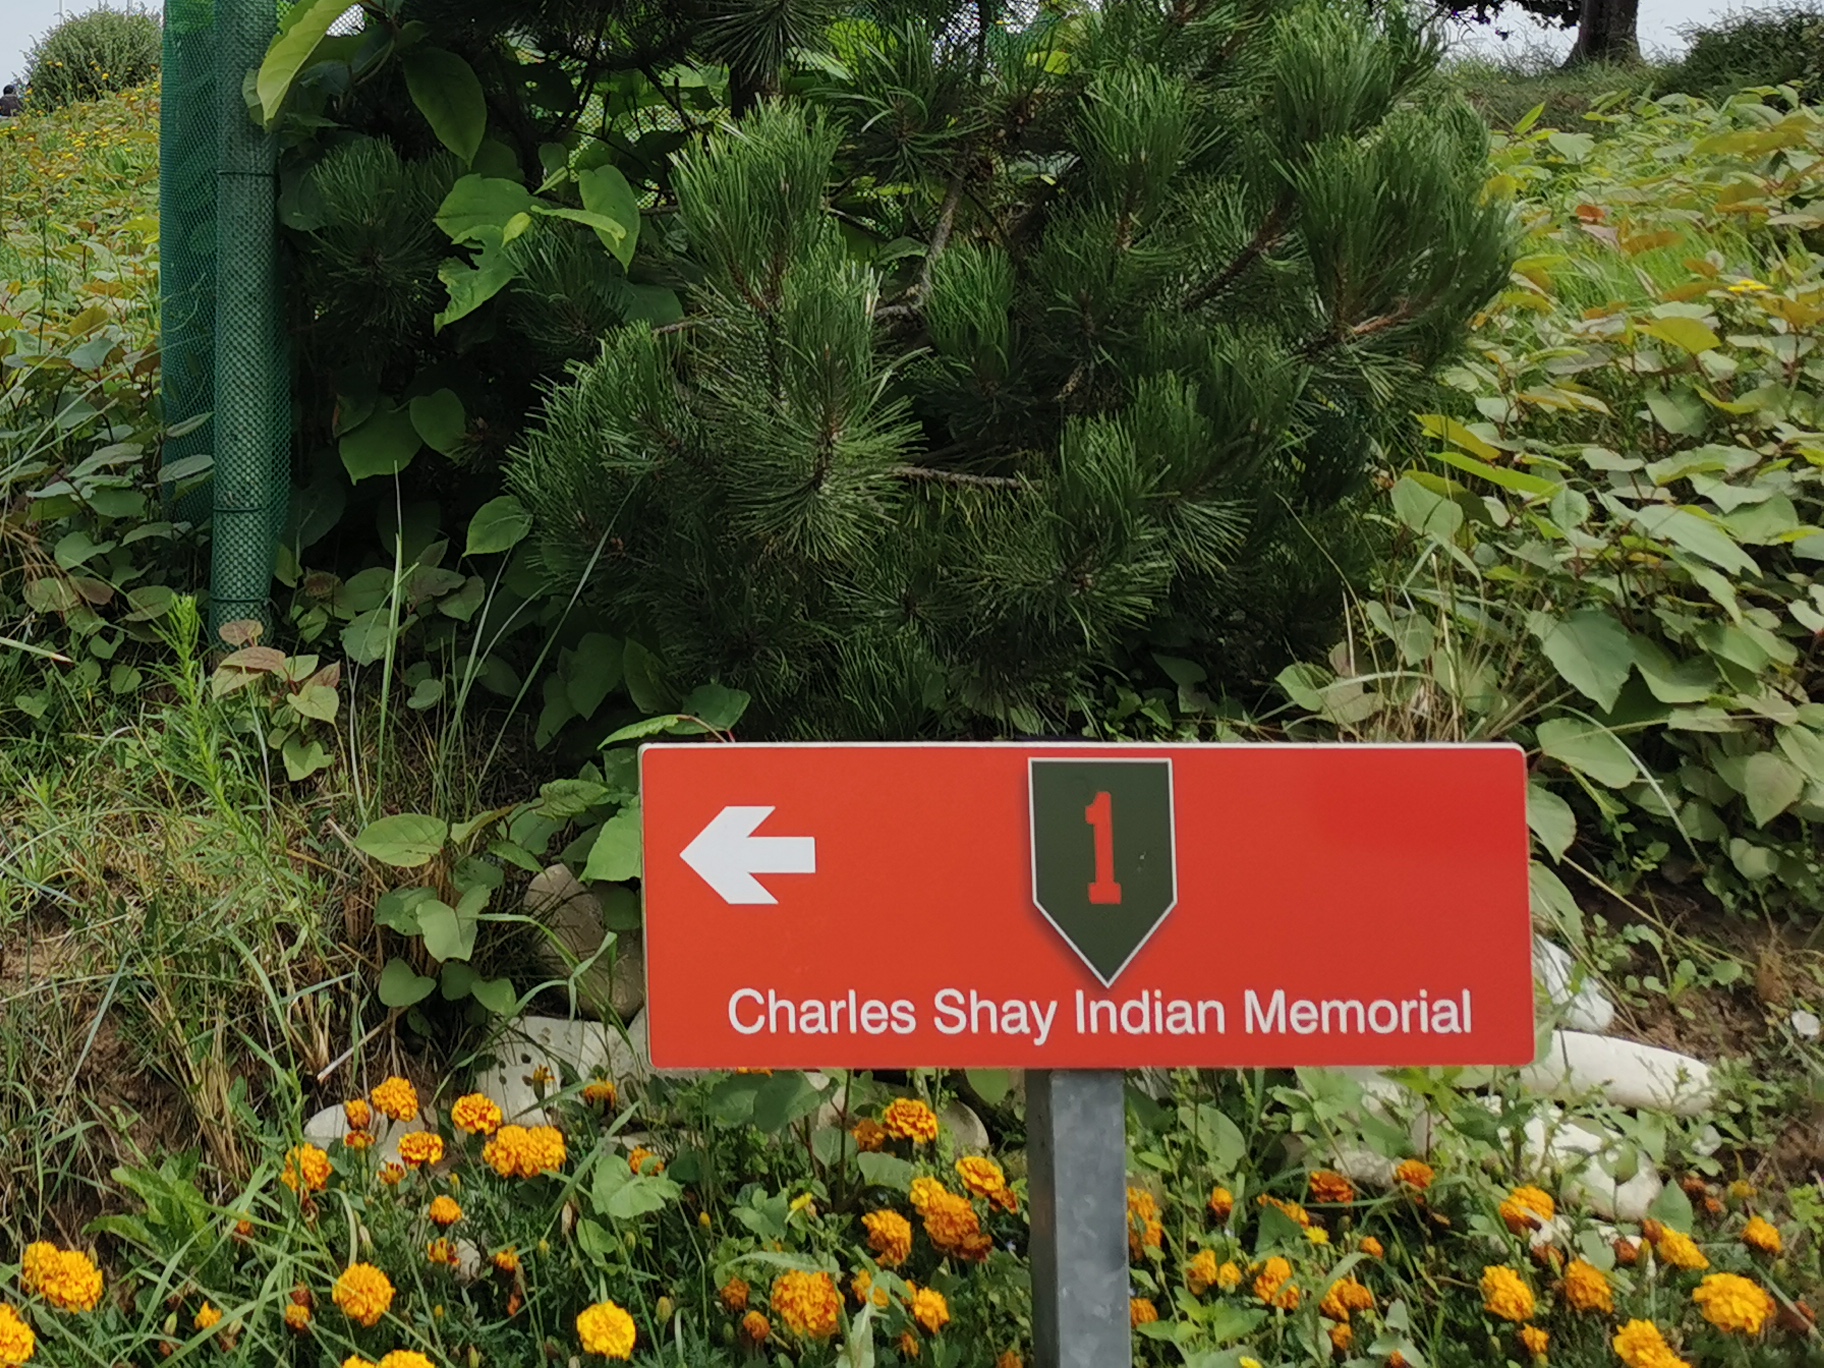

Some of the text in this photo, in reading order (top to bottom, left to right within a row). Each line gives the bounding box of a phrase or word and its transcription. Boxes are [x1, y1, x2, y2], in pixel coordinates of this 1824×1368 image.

[1084, 790, 1122, 905] 1
[727, 988, 1471, 1046] Charles Shay Indian Memorial
